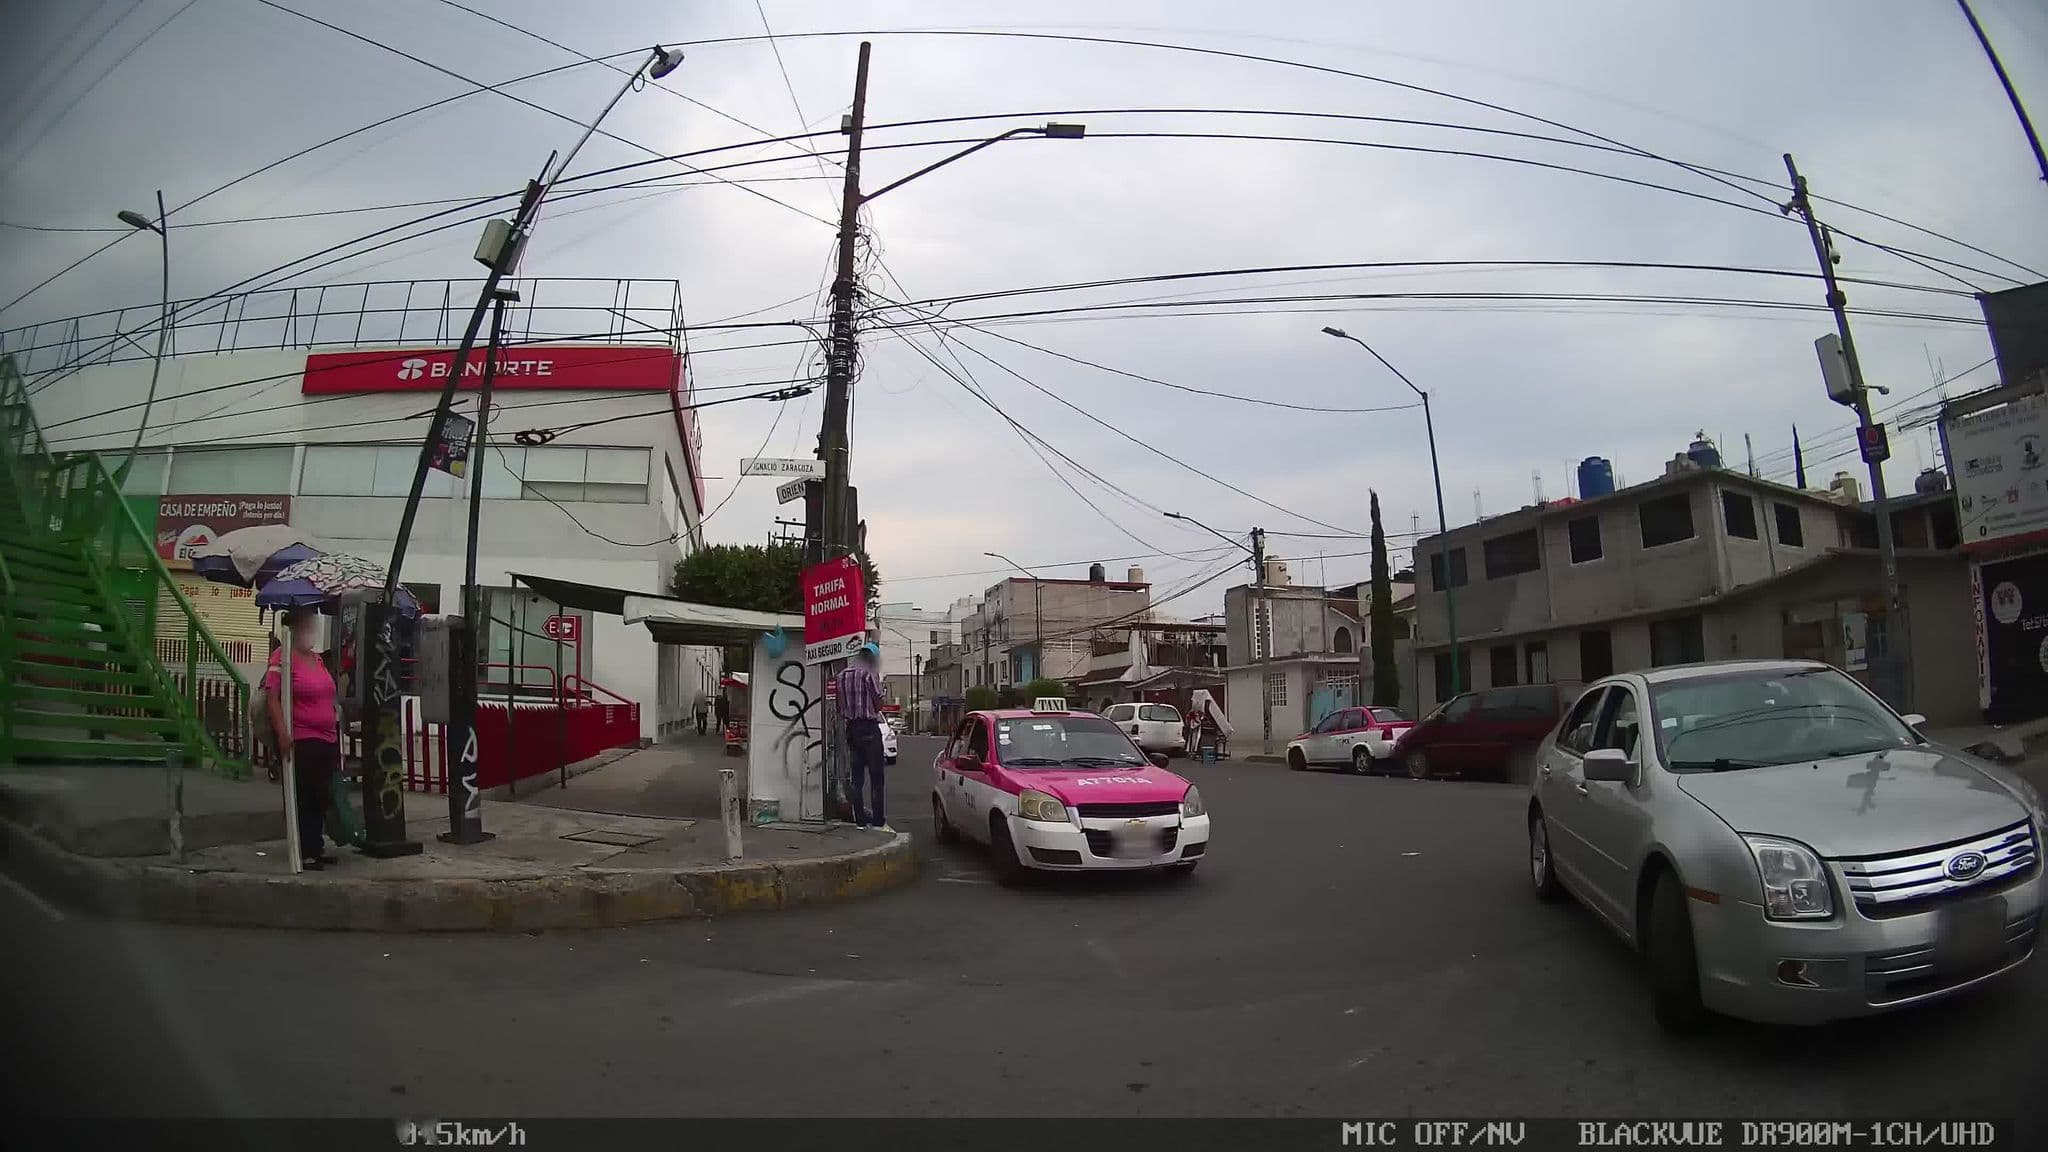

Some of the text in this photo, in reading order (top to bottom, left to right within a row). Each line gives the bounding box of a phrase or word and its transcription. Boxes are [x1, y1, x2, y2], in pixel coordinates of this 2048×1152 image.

[431, 361, 553, 377] BNRTE
[753, 463, 814, 473] IGNACIO ZARAGOZA
[160, 500, 237, 517] CASA DE EMPEÑO
[813, 577, 845, 597] TARIFA
[811, 595, 850, 616] NORMAL
[818, 642, 842, 658] SEGURO
[1038, 699, 1064, 711] TAXI
[1954, 857, 1977, 871] Ford
